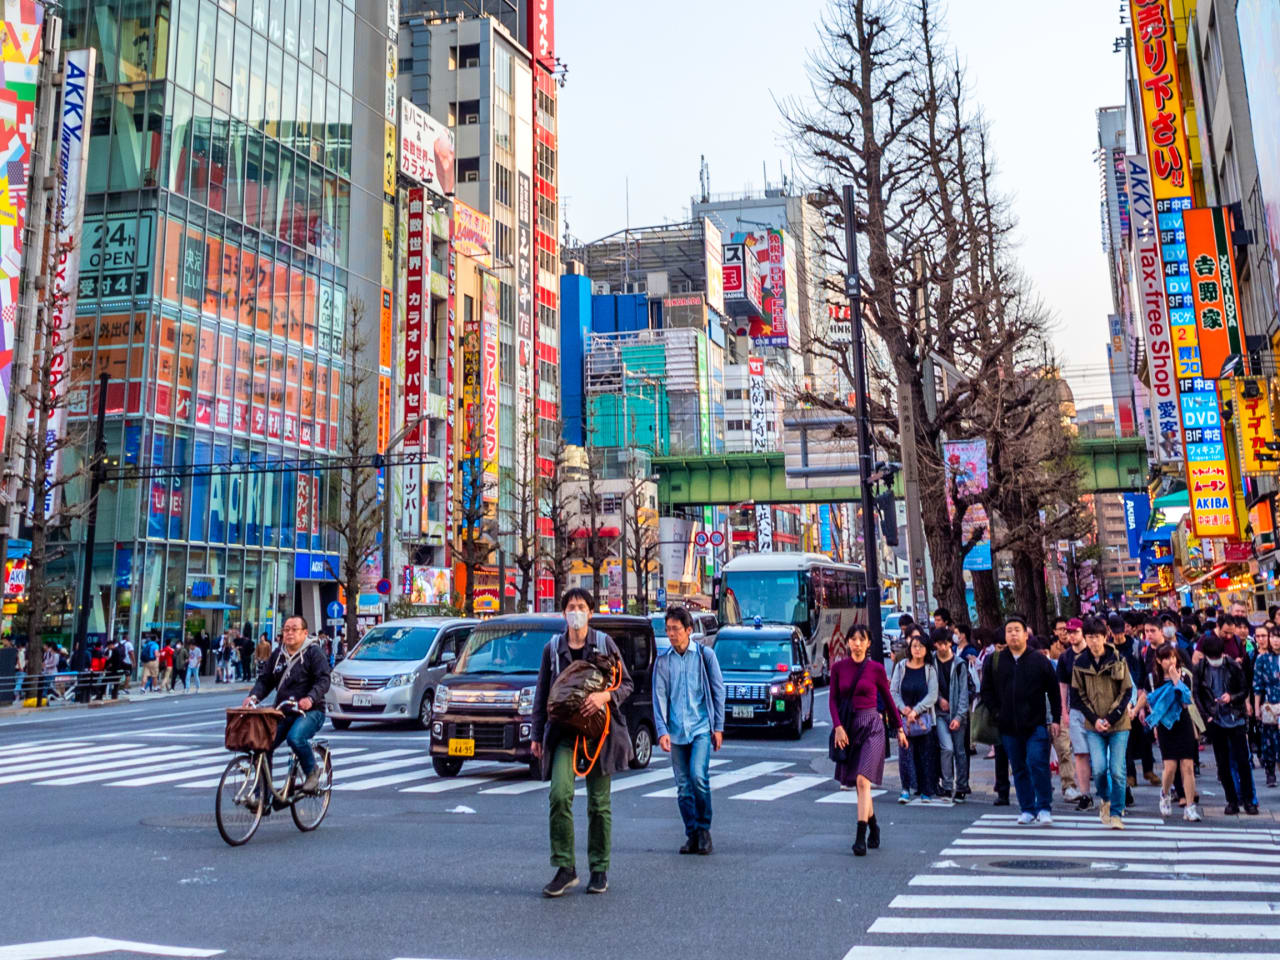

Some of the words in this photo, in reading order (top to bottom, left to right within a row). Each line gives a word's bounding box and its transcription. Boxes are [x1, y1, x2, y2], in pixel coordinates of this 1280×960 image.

[62, 60, 86, 142] AKKY
[1156, 200, 1170, 212] 6F
[1171, 197, 1191, 210] 中古
[89, 252, 135, 266] OPEN
[1165, 262, 1178, 274] 4F
[1193, 255, 1223, 330] 吉野家
[1169, 295, 1182, 307] 3F
[1151, 340, 1171, 397] Shop
[1179, 378, 1192, 390] 1F
[485, 342, 497, 458] ラムタラ
[1185, 411, 1217, 426] DVD
[1196, 498, 1229, 509] AKIBA
